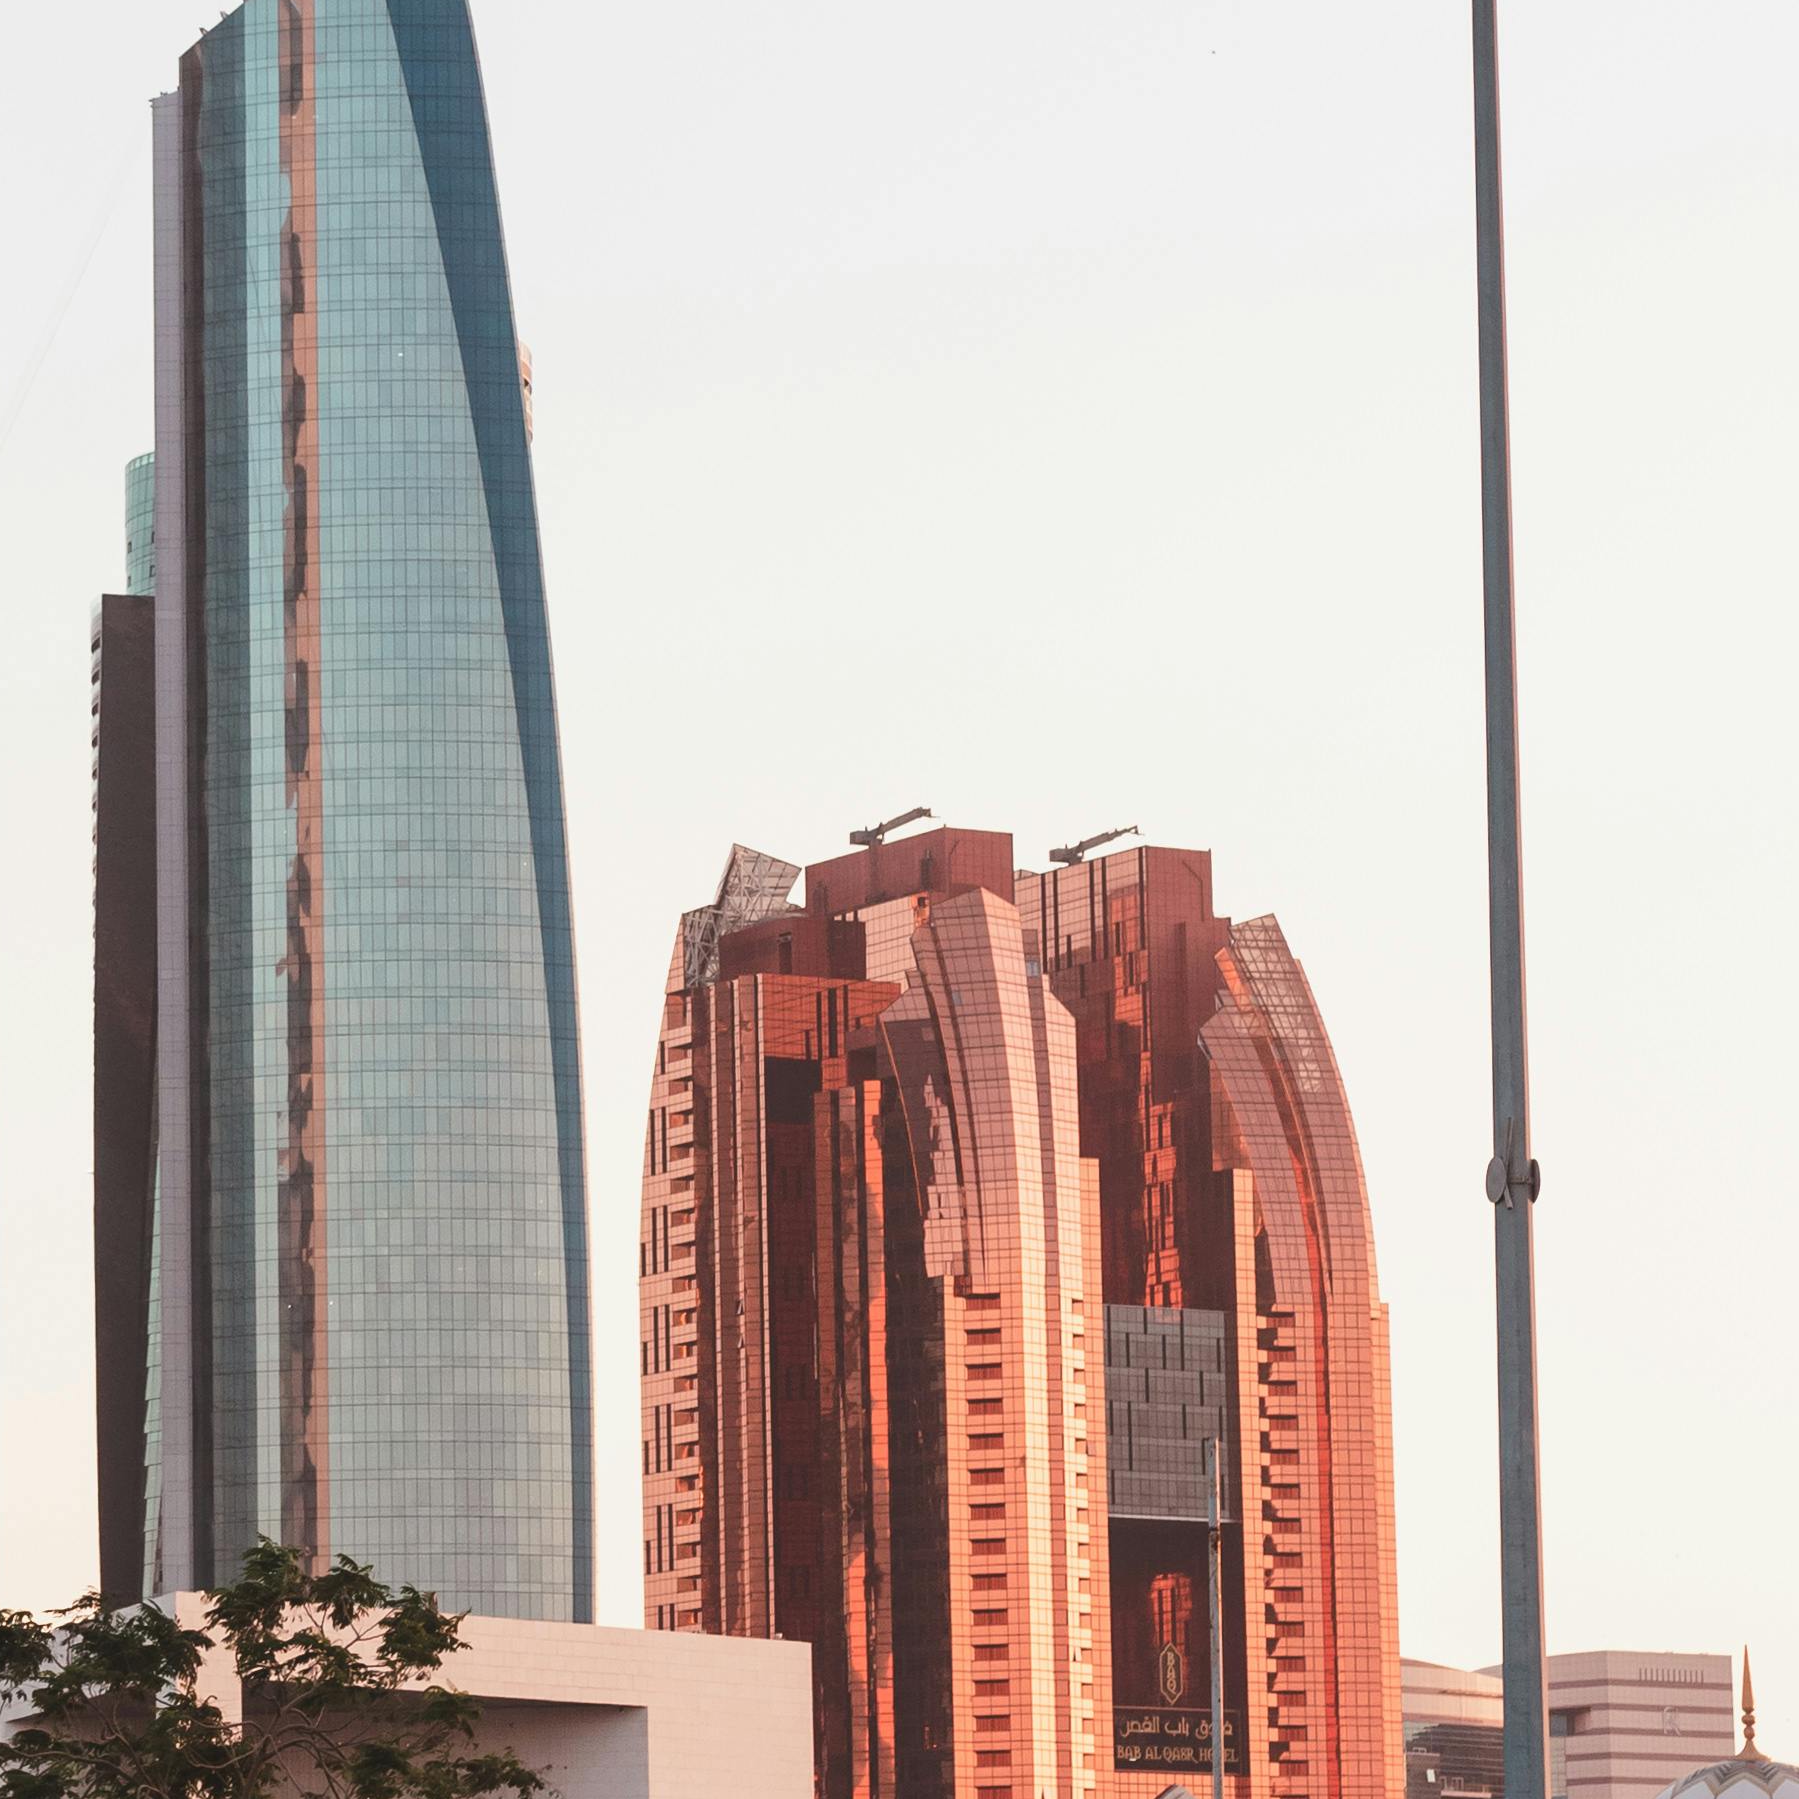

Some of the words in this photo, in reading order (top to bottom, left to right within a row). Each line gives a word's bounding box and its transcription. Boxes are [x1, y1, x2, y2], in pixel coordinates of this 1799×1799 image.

[1119, 1715, 1160, 1738] القصر
[1164, 1717, 1190, 1737] باب
[1117, 1745, 1141, 1761] BAB
[1145, 1746, 1161, 1760] AL
[1162, 1746, 1199, 1764] QASR
[1200, 1748, 1239, 1762] HOEL
